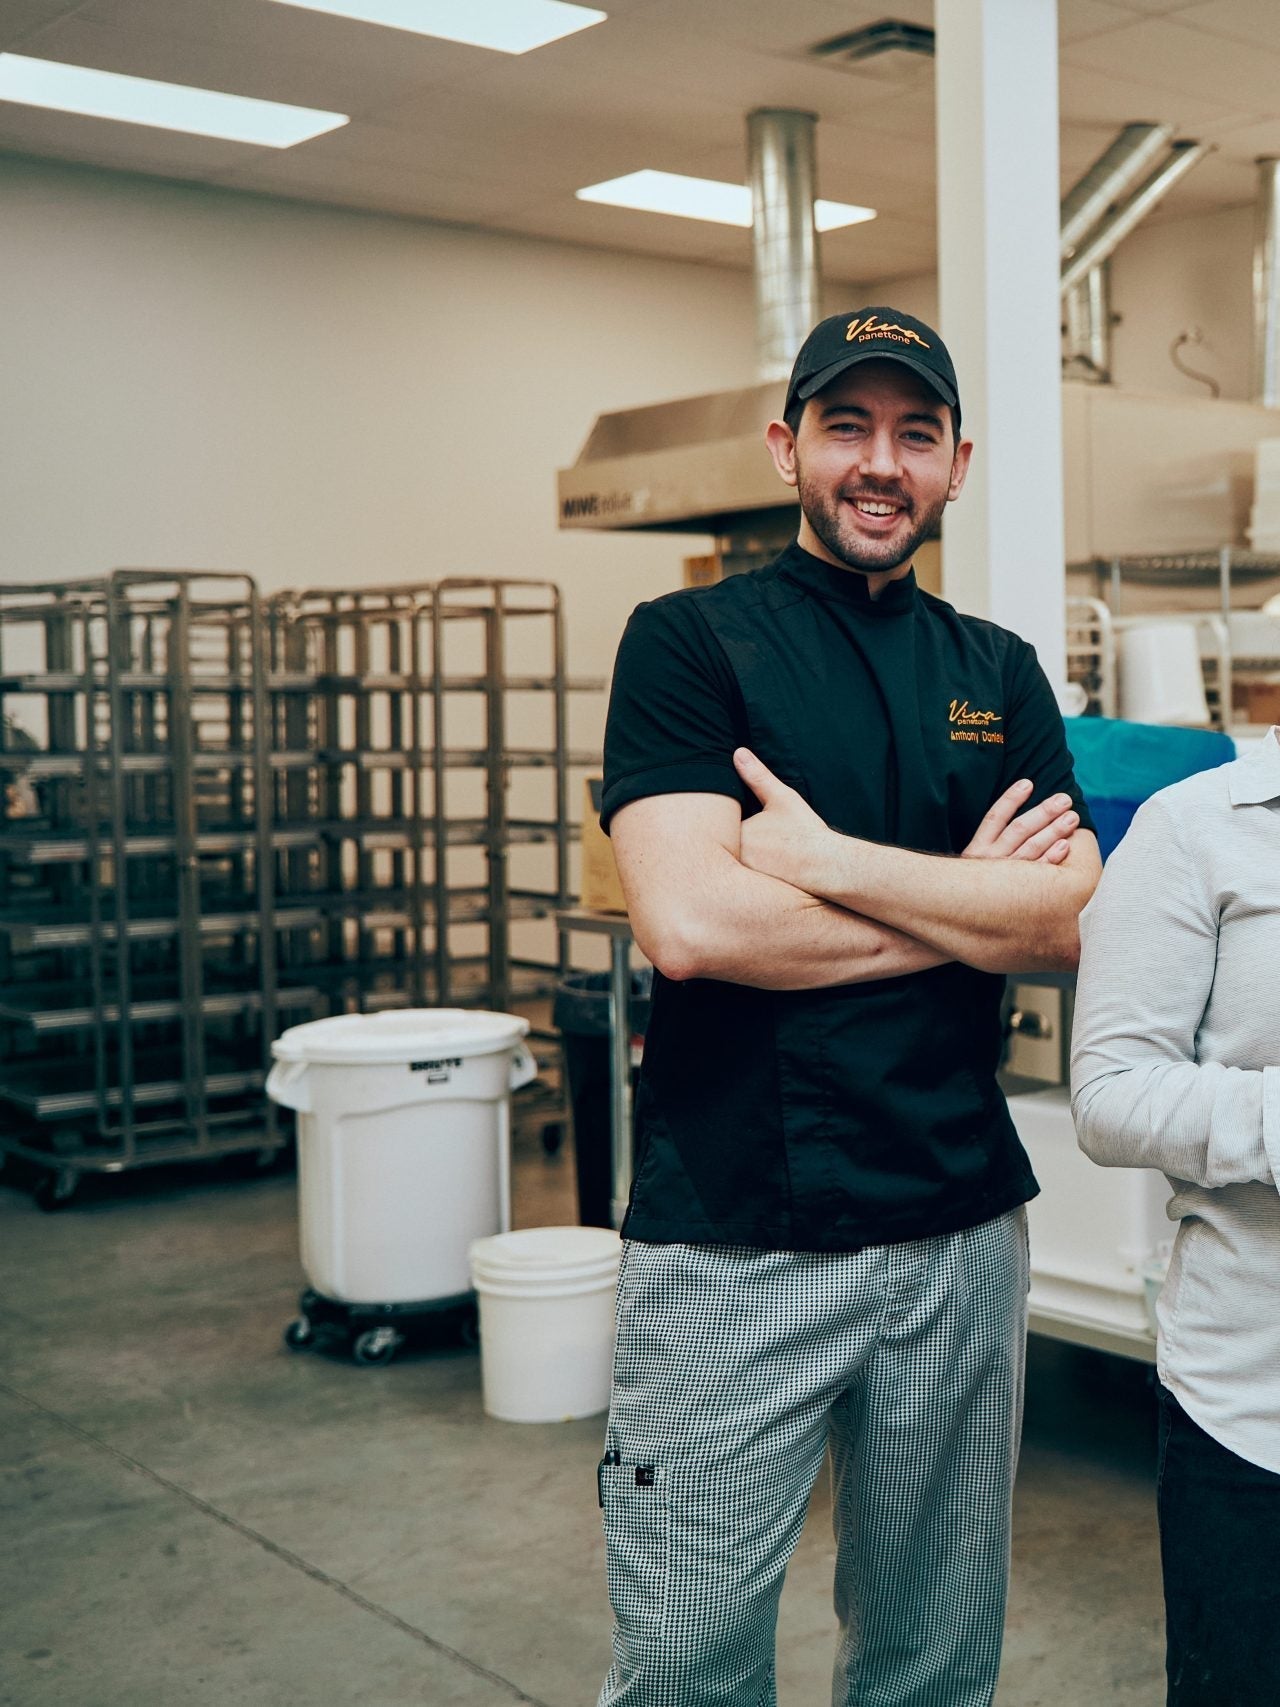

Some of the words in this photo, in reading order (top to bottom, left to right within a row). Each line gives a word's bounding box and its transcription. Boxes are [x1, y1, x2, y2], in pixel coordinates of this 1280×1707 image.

[846, 315, 930, 348] Viva
[858, 331, 911, 345] panettone
[949, 699, 1002, 721] Viva
[950, 730, 979, 744] Anthony
